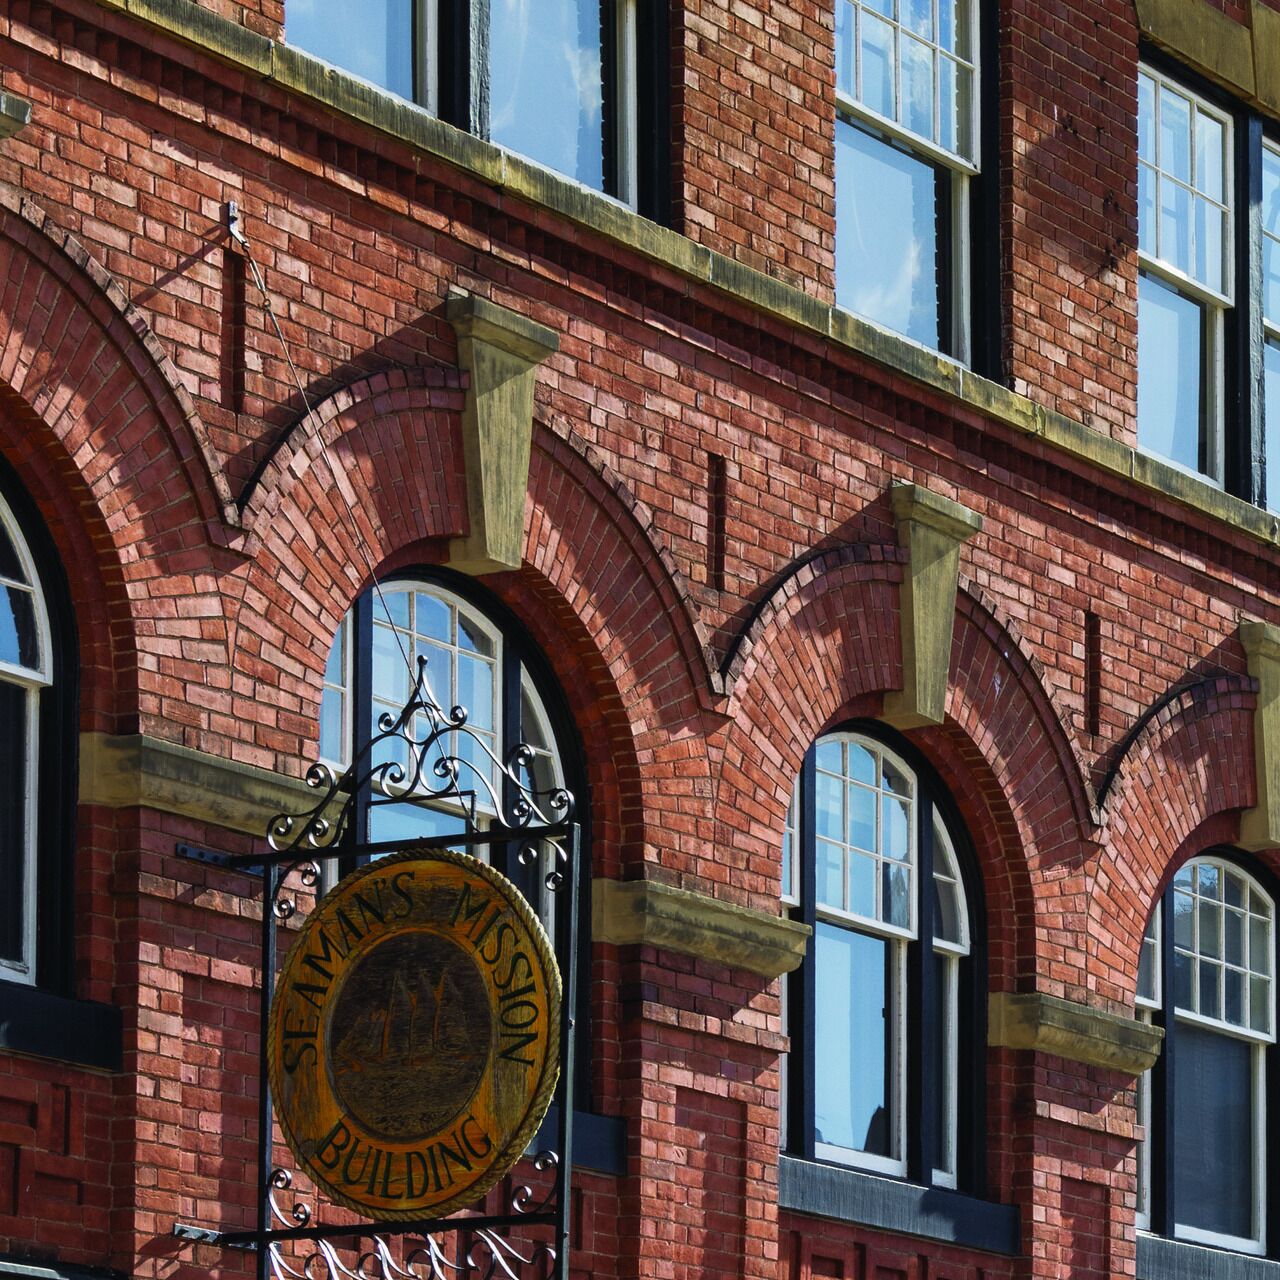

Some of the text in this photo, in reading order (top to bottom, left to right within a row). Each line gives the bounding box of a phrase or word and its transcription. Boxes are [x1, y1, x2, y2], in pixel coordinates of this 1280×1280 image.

[283, 871, 540, 1074] SEAMAN'S MISSION
[315, 1115, 494, 1200] BUILDING
